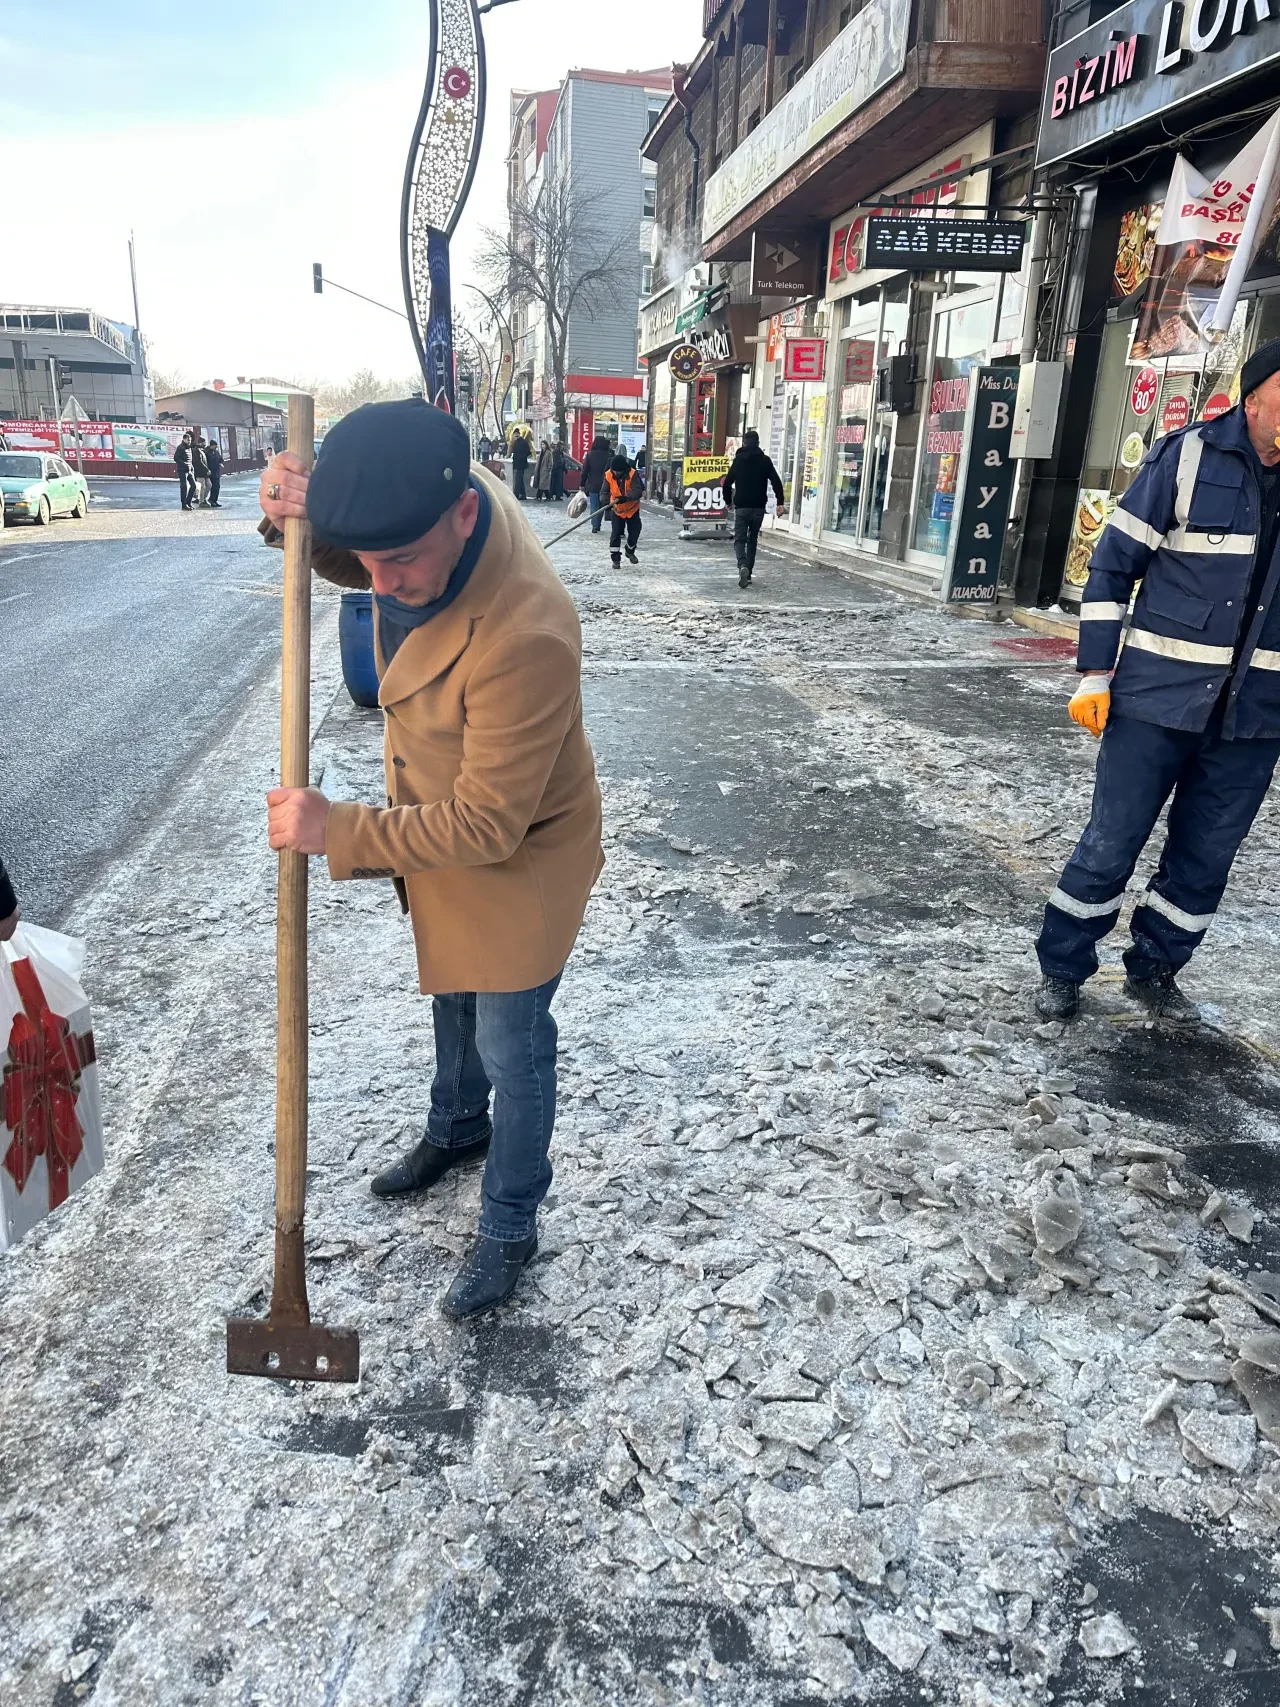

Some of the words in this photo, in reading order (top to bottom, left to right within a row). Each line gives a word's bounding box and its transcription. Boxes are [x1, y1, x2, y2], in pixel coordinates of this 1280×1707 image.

[1051, 30, 1139, 119] BİZİM
[1181, 204, 1245, 223] BAŞL
[937, 231, 1021, 255] KEBAP
[757, 281, 773, 289] Türk
[775, 281, 805, 290] Telekom
[673, 347, 697, 361] CAFE
[793, 346, 815, 373] E
[980, 376, 1000, 389] Miss
[931, 378, 968, 414] SULTA
[1135, 391, 1150, 410] 80
[1165, 411, 1186, 420] DÜRÜM
[927, 431, 964, 454] ECZANE
[684, 487, 726, 510] 299
[967, 401, 1009, 575] Bayan
[951, 583, 995, 600] KUAFÖRÜ
